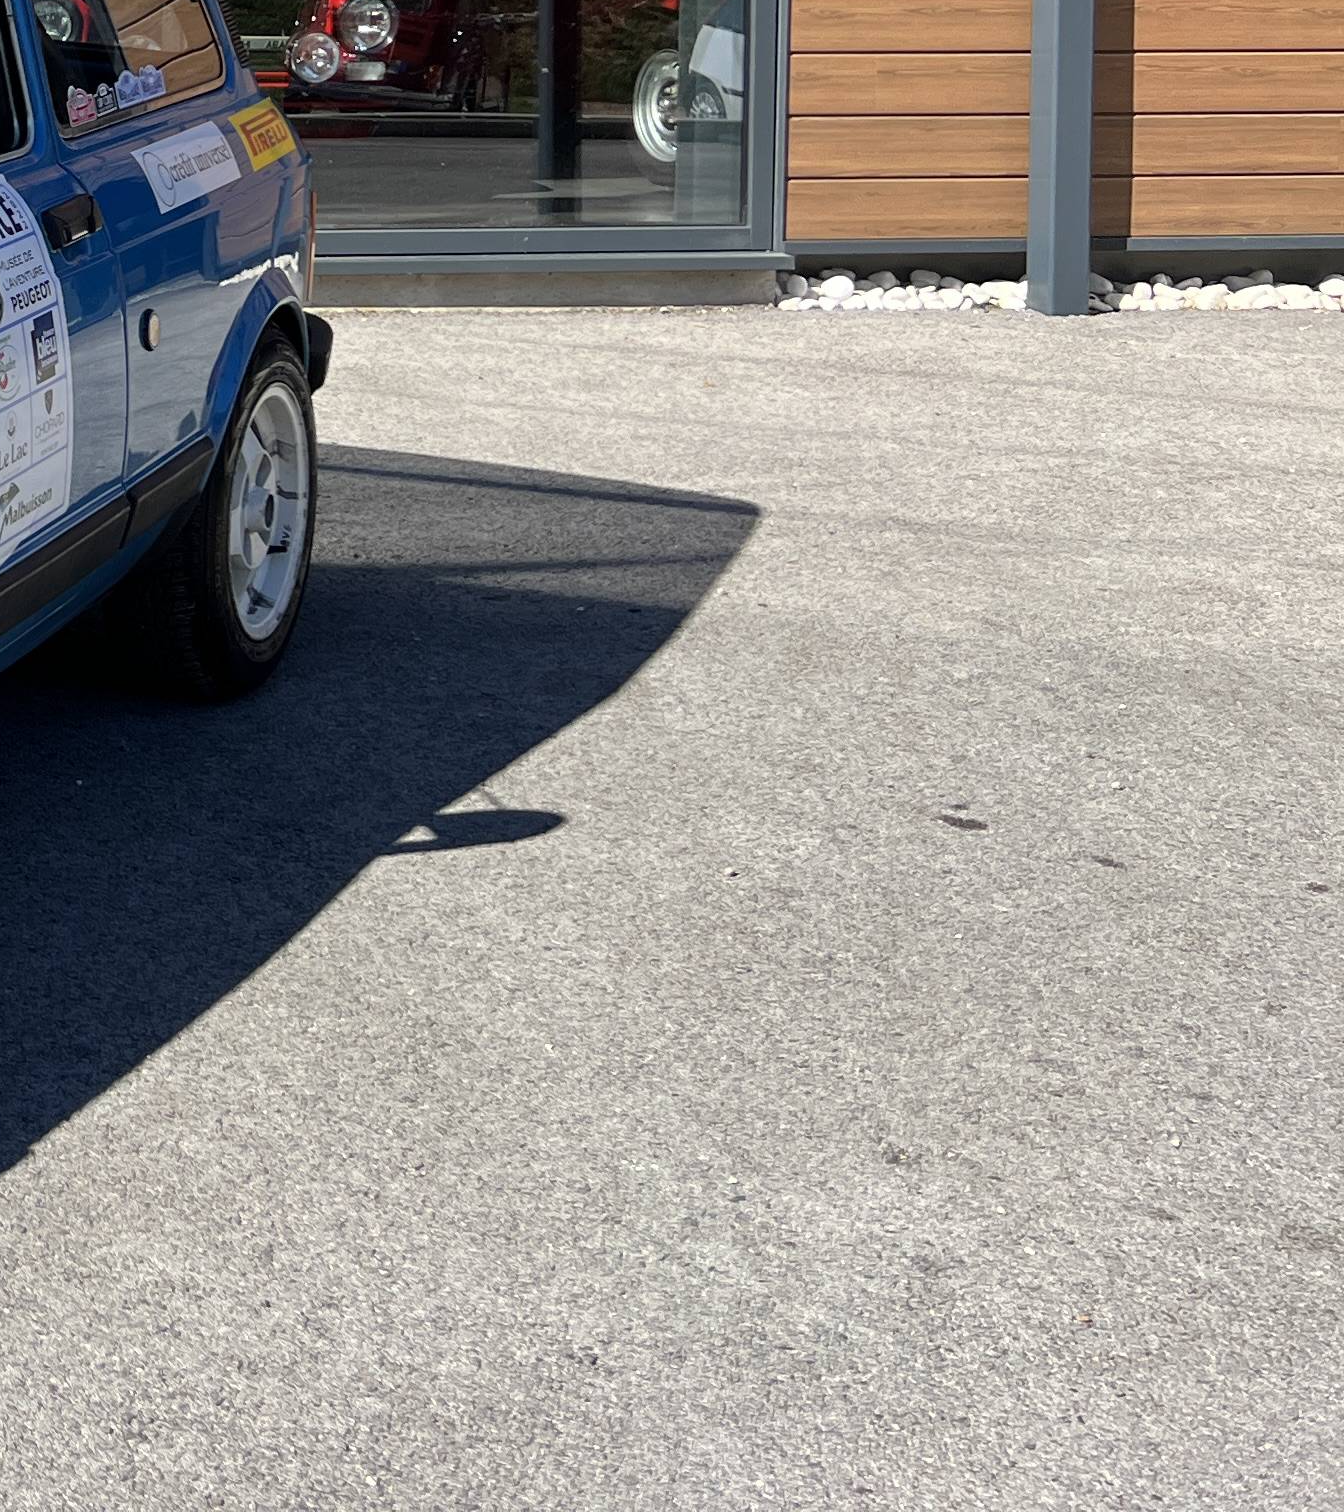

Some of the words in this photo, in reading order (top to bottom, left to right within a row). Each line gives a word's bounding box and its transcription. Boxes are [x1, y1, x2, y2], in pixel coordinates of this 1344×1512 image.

[240, 107, 288, 156] PIRELLI
[10, 279, 52, 312] PEUGEOT
[36, 335, 57, 360] bleu
[11, 441, 28, 465] Lac
